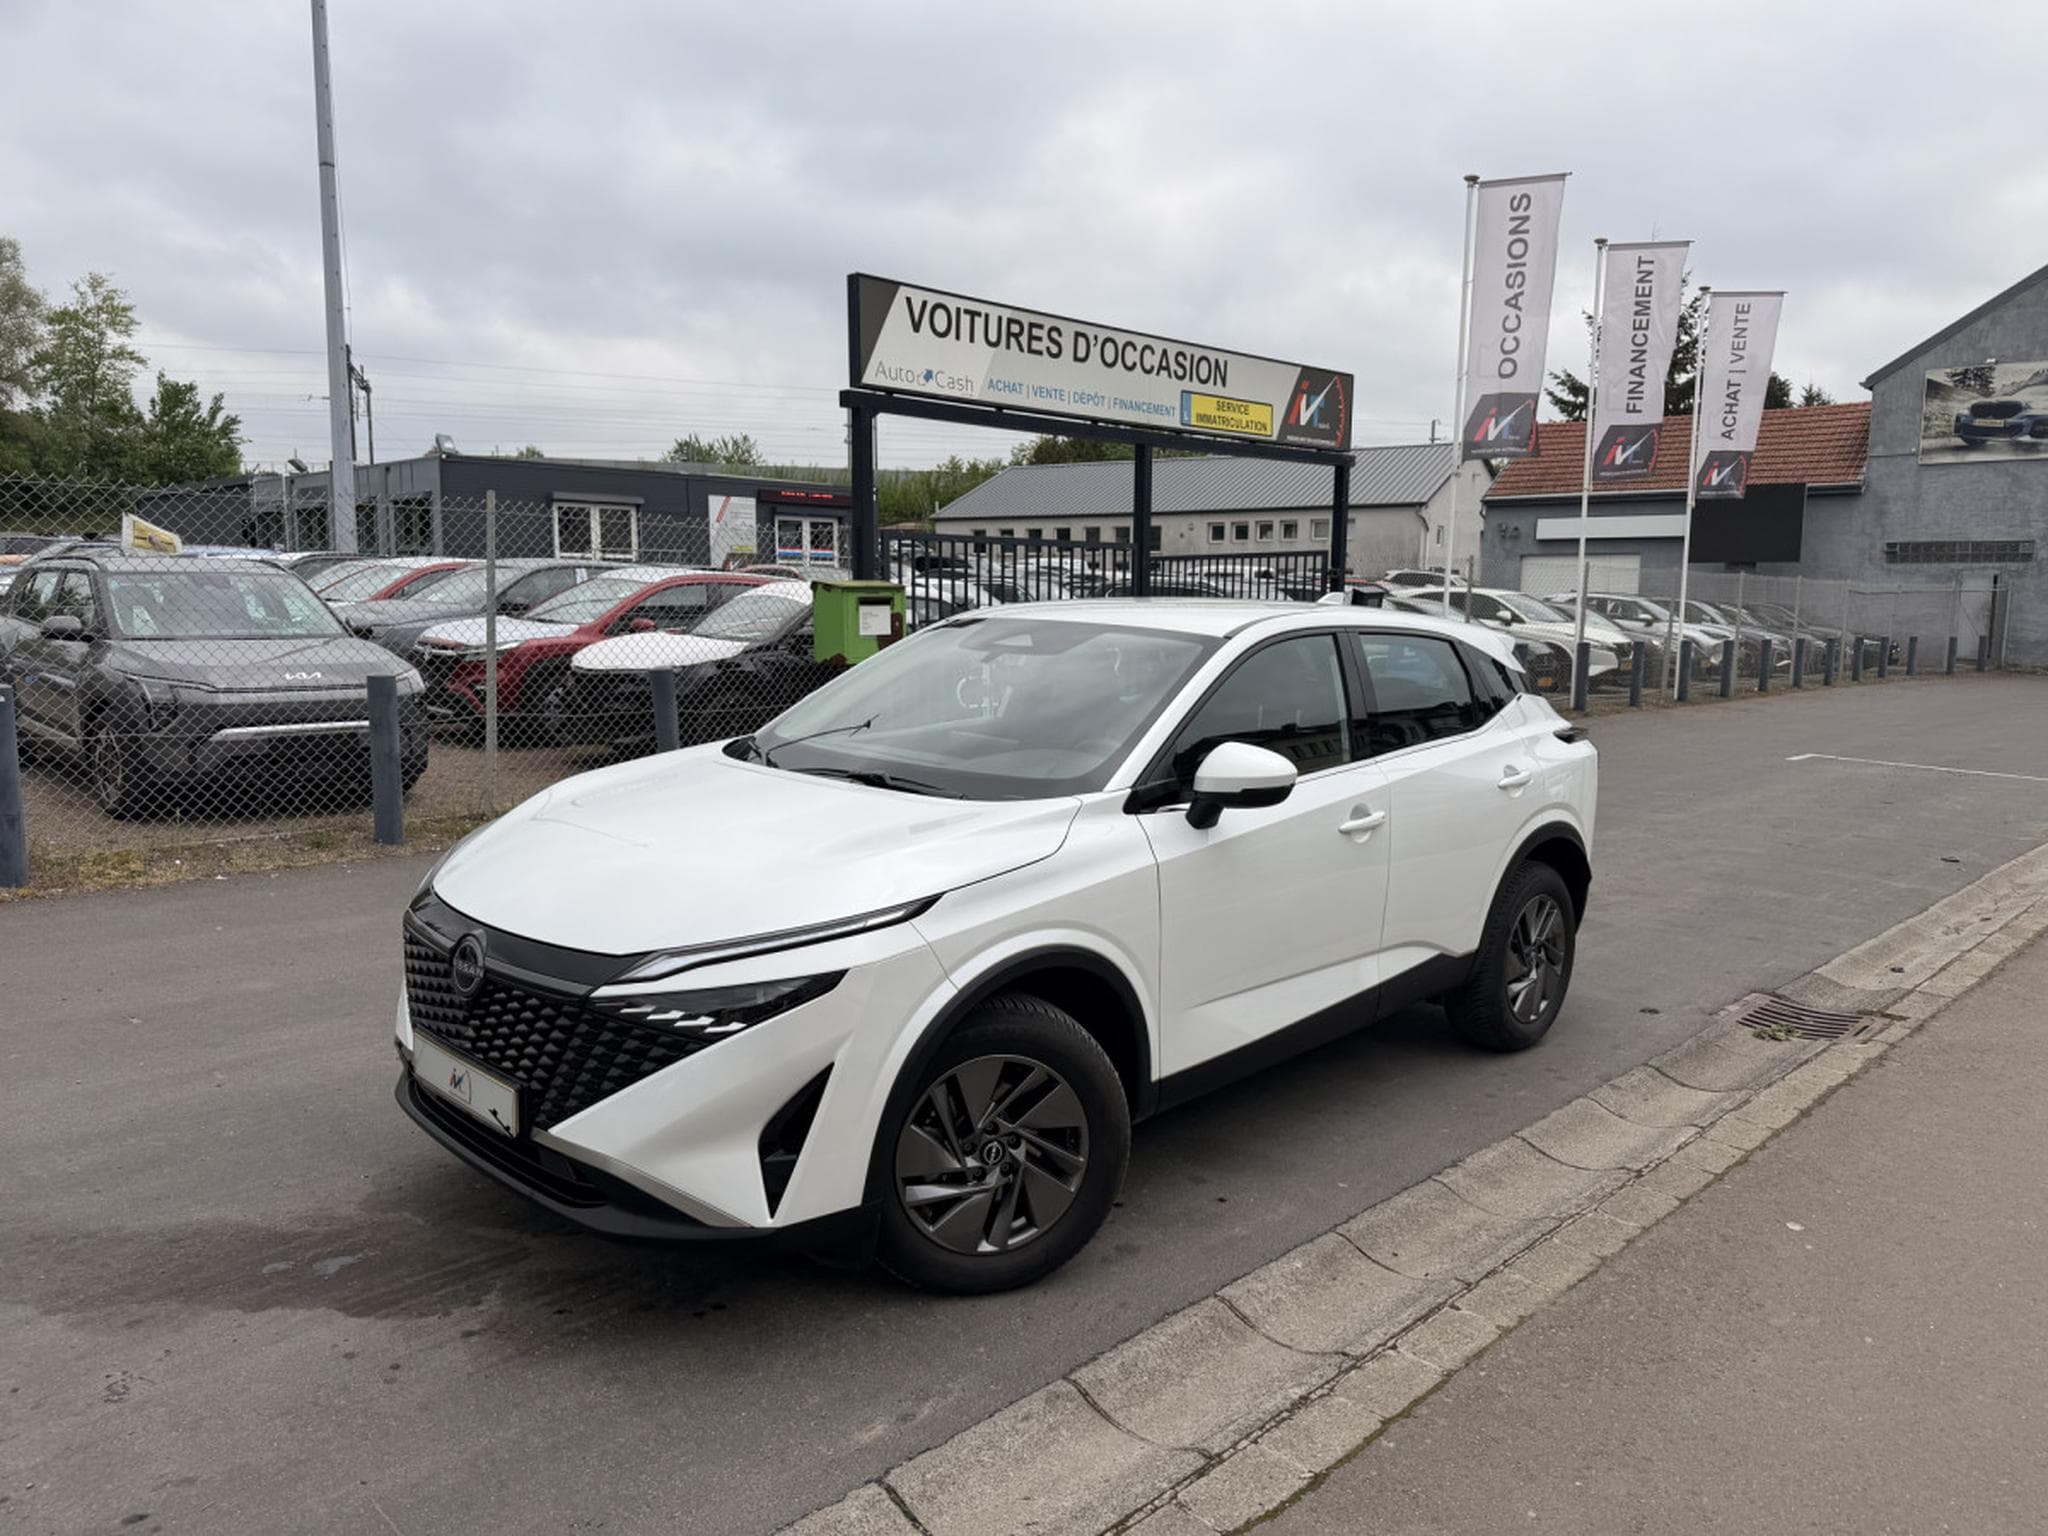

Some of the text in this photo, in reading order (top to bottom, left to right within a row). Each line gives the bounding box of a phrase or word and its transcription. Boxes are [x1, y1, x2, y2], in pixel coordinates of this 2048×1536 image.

[1497, 191, 1532, 379] OCCASIONS
[905, 296, 1228, 388] VOITURES D'OCCASION
[1626, 255, 1655, 414] FINANCEMENT
[1730, 303, 1751, 364] VENTE
[875, 360, 974, 393] Auto Cash
[987, 378, 1024, 395] ACHAT
[1031, 385, 1065, 401] VENTE
[1113, 397, 1175, 417] FINANCEMENT
[1196, 412, 1267, 431] IMMATRICULATION
[1216, 400, 1250, 415] SERVICE
[1721, 379, 1742, 441] ACHAT
